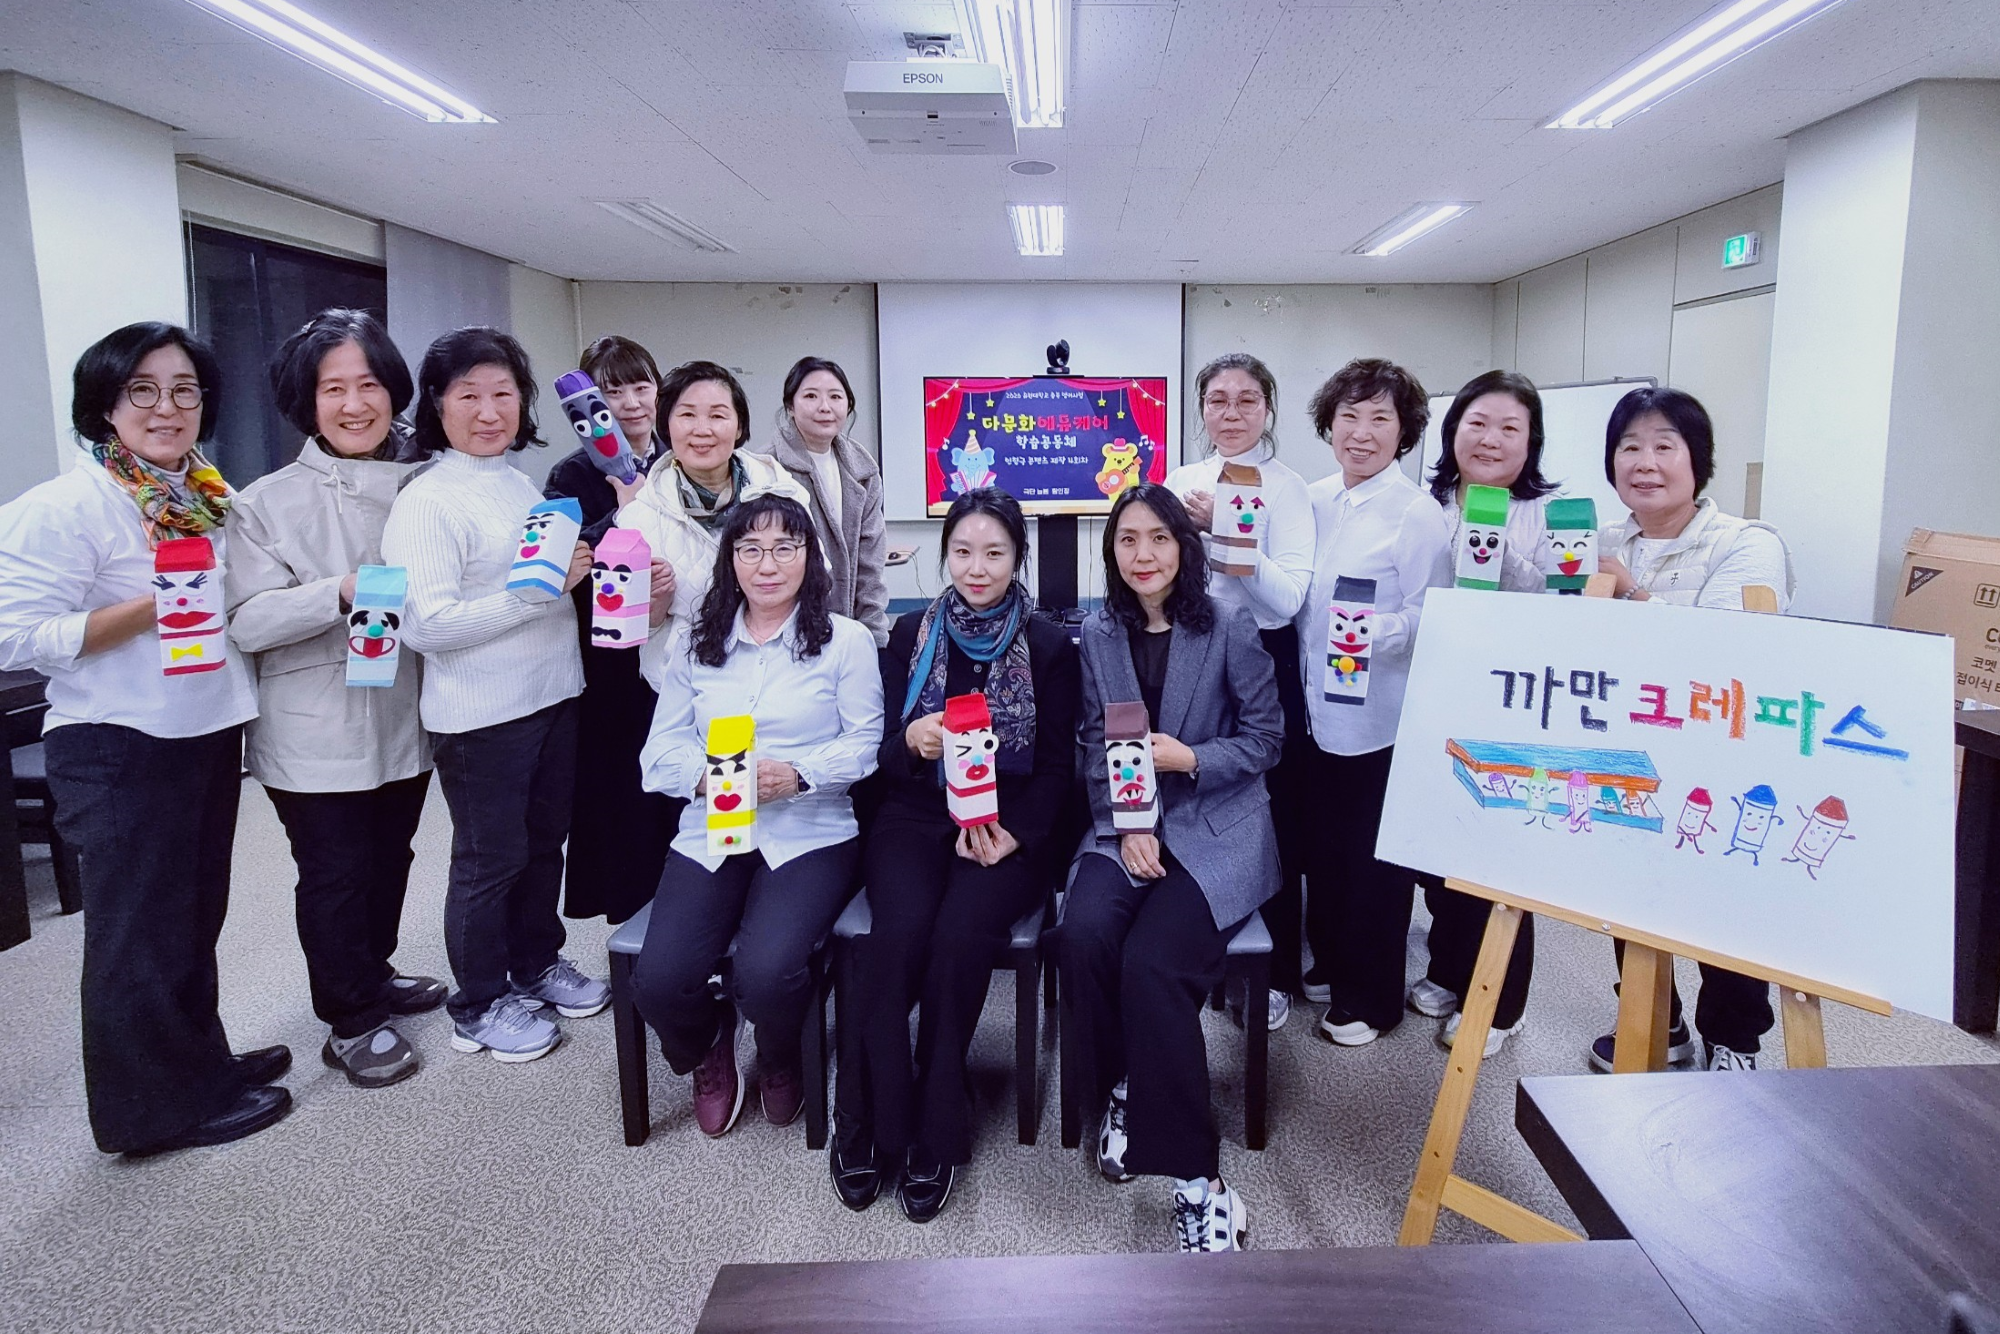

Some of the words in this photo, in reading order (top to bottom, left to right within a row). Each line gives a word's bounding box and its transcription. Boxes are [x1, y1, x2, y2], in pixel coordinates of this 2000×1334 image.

[902, 73, 943, 84] EPSON
[982, 412, 1109, 434] 다문화에듀케어
[1015, 434, 1077, 450] 학습공동체
[1050, 456, 1066, 465] 제작
[1911, 571, 1935, 589] CAUTION
[1985, 627, 2000, 643] C
[1970, 656, 1998, 673] 코멧
[1956, 671, 1993, 692] 접이식
[1490, 665, 1620, 733] 까만
[1629, 678, 1909, 762] 크레파스
